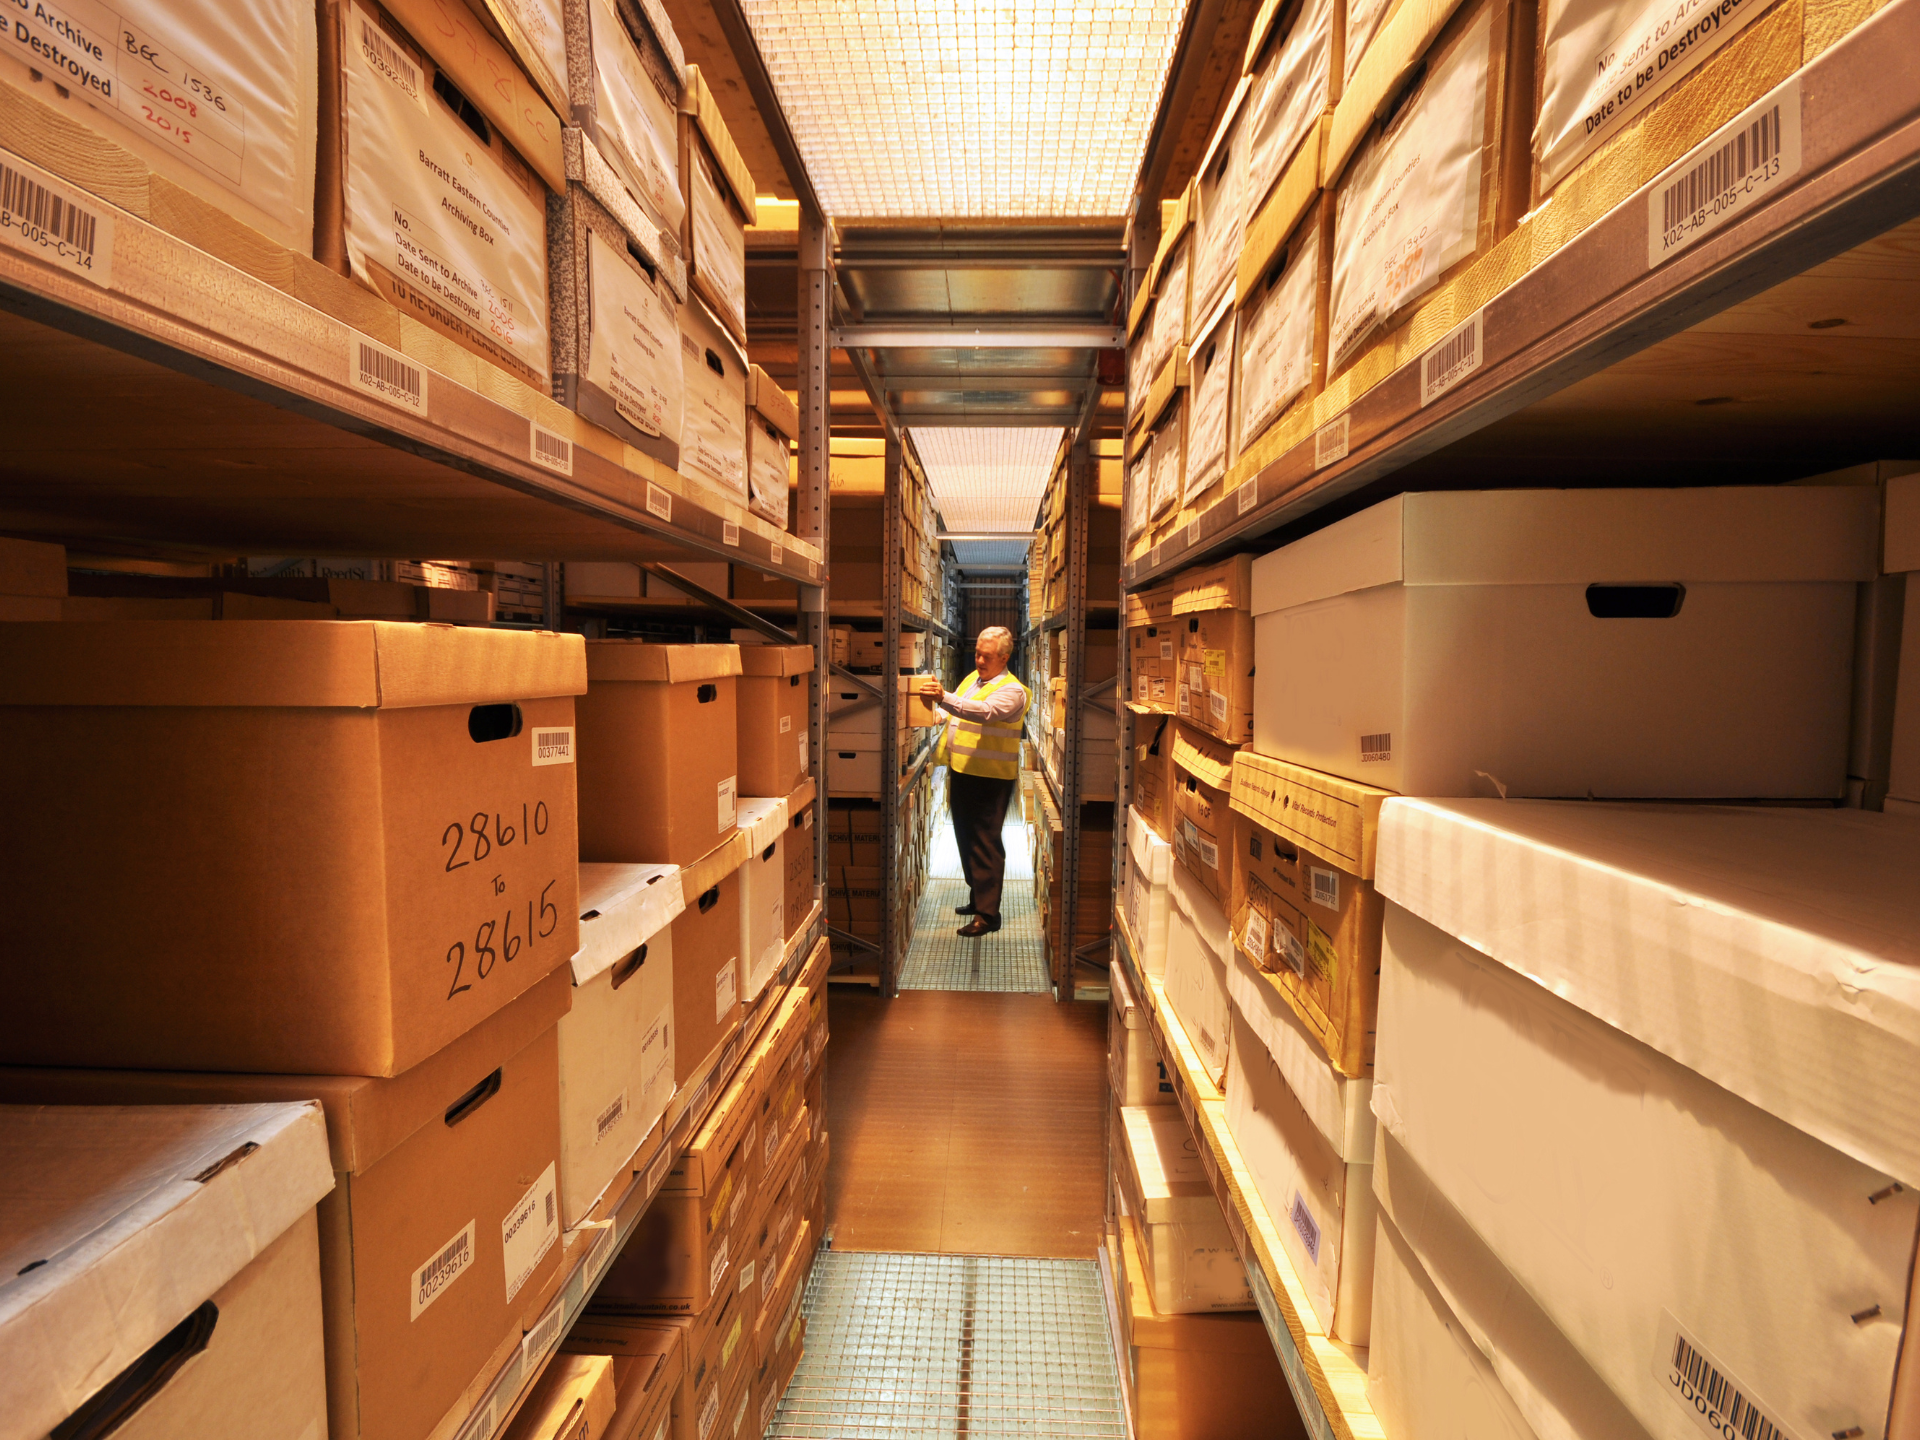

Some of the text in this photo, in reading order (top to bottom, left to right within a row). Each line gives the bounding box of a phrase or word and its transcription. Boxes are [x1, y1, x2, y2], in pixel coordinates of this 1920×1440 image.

[16, 20, 111, 98] Destroyed
[35, 2, 103, 61] Archive
[1620, 36, 1651, 75] Sent
[1655, 20, 1670, 42] to
[143, 78, 198, 118] 2008
[1585, 100, 1614, 135] Date
[1617, 84, 1632, 106] to
[1636, 66, 1654, 91] be
[394, 210, 412, 232] No.
[419, 149, 510, 236] Barratt Eastern Counties
[441, 197, 494, 246] Archiving Box
[1662, 157, 1780, 252] X02-AB-005-C-13
[0, 210, 92, 270] B-005-C-14
[395, 231, 478, 300] Date Sent to Archive
[398, 253, 480, 321] Date to be Destroyed
[537, 744, 570, 760] 00377441
[1361, 752, 1391, 763] JD060480
[442, 800, 549, 873] 28610
[828, 834, 852, 843] RCHIVE
[490, 873, 506, 896] To
[446, 879, 557, 1000] 28615
[504, 1200, 536, 1244] 00239616
[418, 1246, 471, 1305] 00239616
